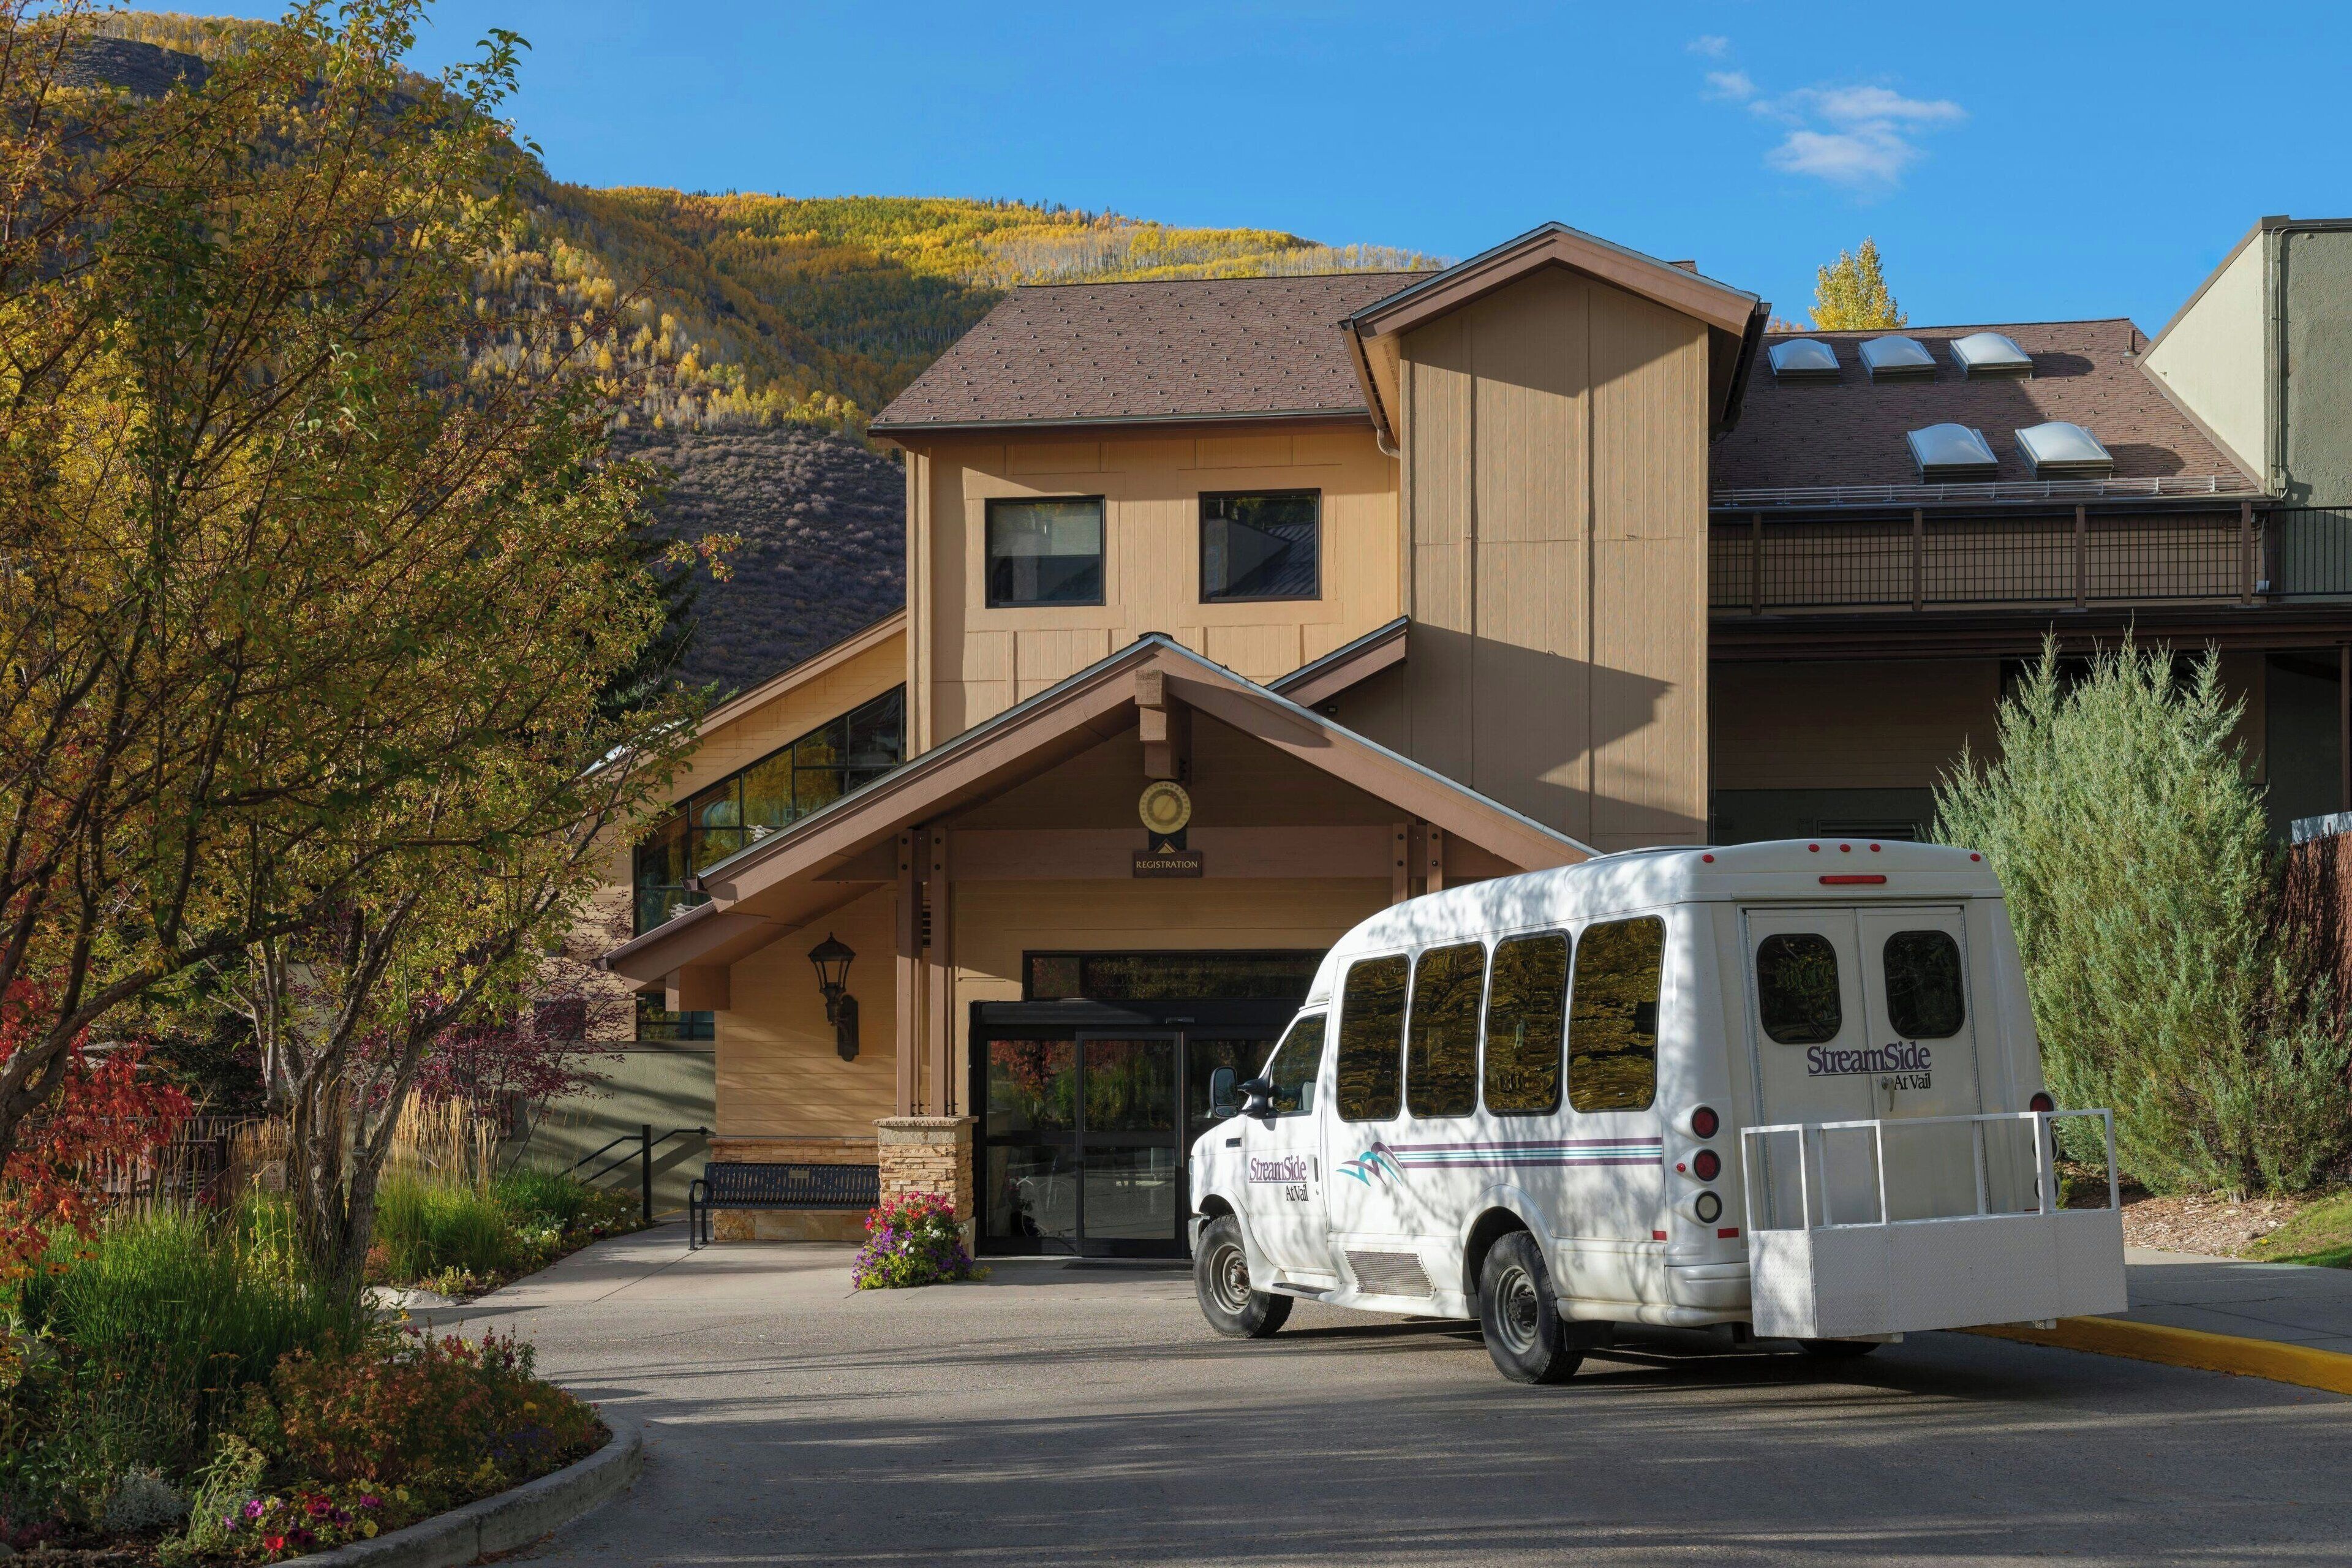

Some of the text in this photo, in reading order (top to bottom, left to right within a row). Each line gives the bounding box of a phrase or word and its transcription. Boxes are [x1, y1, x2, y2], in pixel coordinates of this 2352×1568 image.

[1807, 1041, 1931, 1074] StreamSide
[1894, 1072, 1931, 1090] At Vail
[1250, 1155, 1306, 1181] StreamSide
[1286, 1183, 1309, 1201] At Vail
